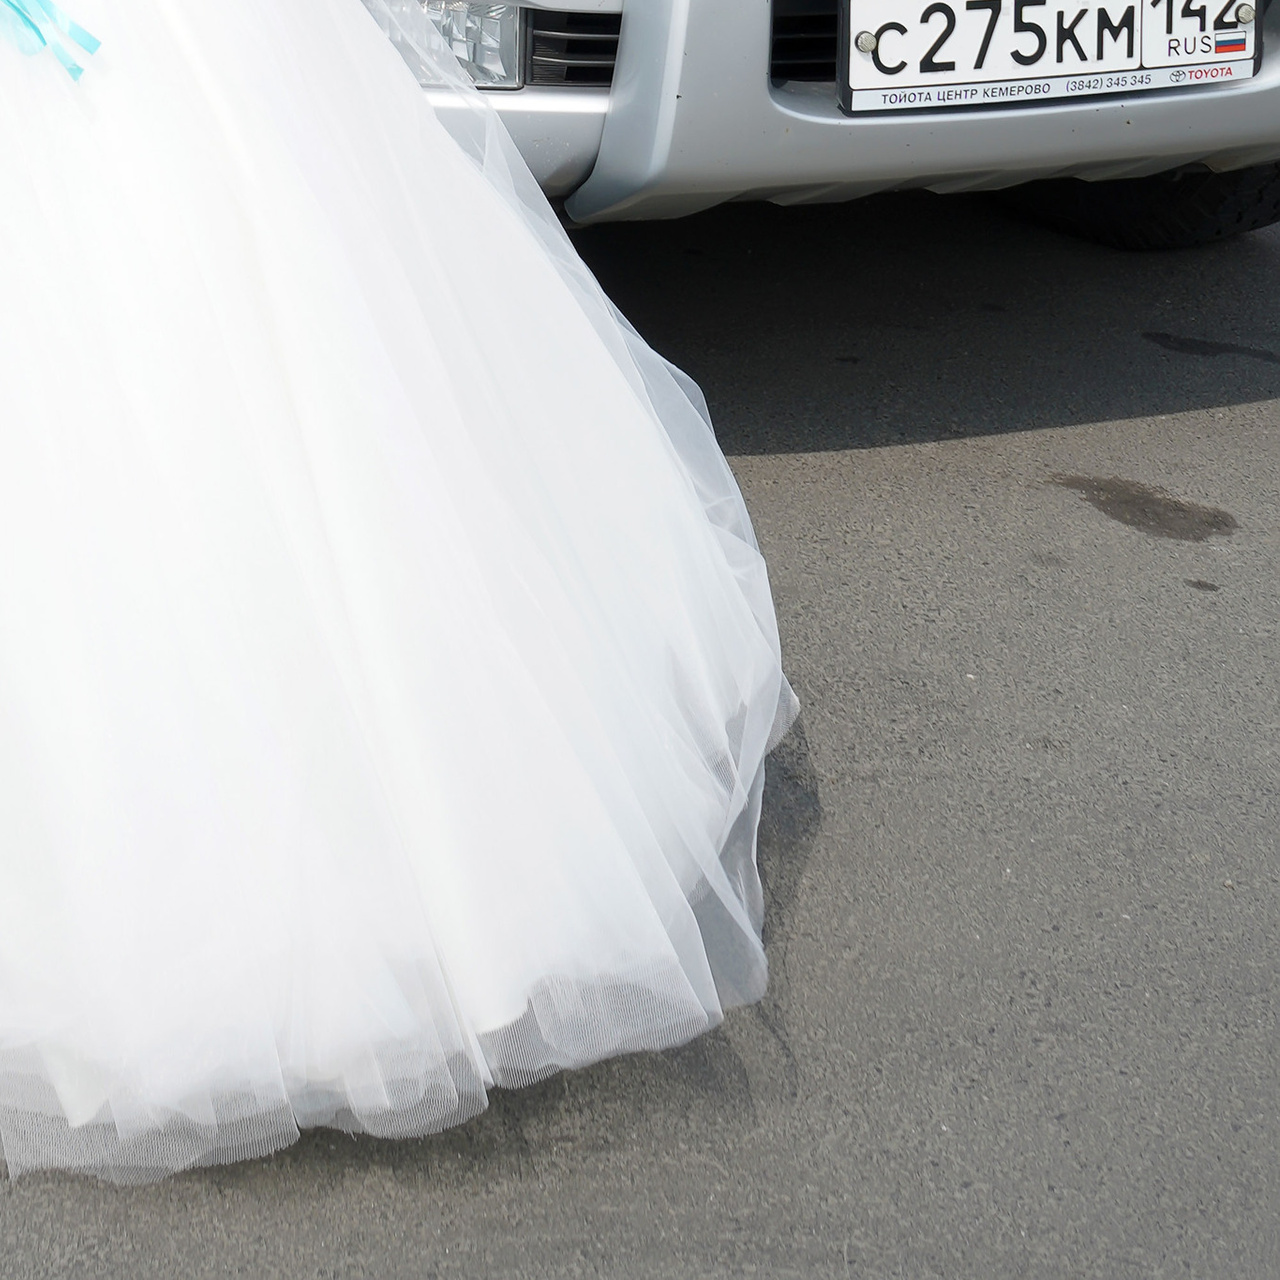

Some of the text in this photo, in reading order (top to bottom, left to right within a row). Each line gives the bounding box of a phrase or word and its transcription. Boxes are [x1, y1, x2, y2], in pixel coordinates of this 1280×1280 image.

[1168, 35, 1212, 57] RUS
[1188, 67, 1233, 81] TOYOTA
[881, 74, 1152, 105] ТОЙОТА ЦЕНТР КЕМЕРОВО (3842) 345 345
